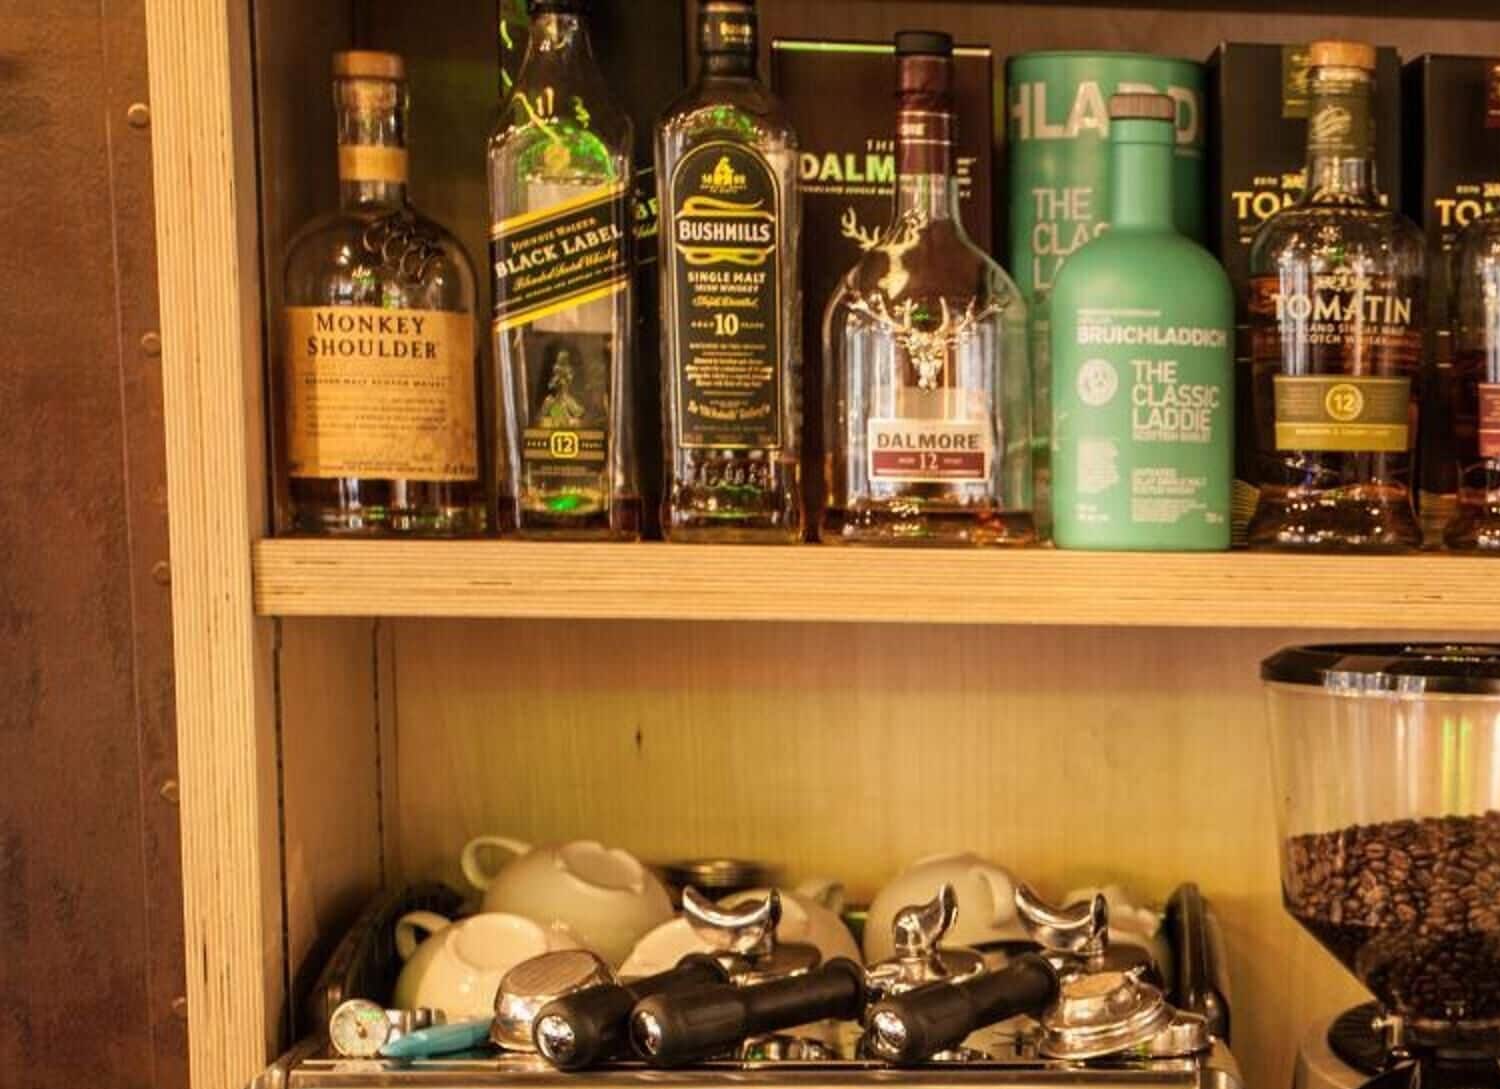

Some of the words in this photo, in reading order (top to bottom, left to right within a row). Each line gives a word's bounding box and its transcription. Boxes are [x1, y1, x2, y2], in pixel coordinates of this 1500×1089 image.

[1033, 188, 1093, 221] THE
[1435, 200, 1490, 227] TO
[679, 220, 771, 243] BUSHMILLS
[495, 245, 558, 279] BLACK
[561, 223, 624, 255] LABEL
[687, 271, 730, 283] SINGLE
[733, 272, 766, 283] MALT
[1272, 293, 1413, 324] TOMATIN
[316, 312, 426, 334] MONKEY
[714, 312, 739, 336] 10
[307, 335, 438, 359] SHOULDER
[1130, 359, 1178, 384] THE
[1132, 383, 1221, 408] CLASSIC
[1333, 394, 1354, 412] 12
[1132, 407, 1212, 433] LADDIE
[556, 437, 573, 454] 12
[877, 432, 982, 450] DALMORE
[919, 452, 940, 470] 12
